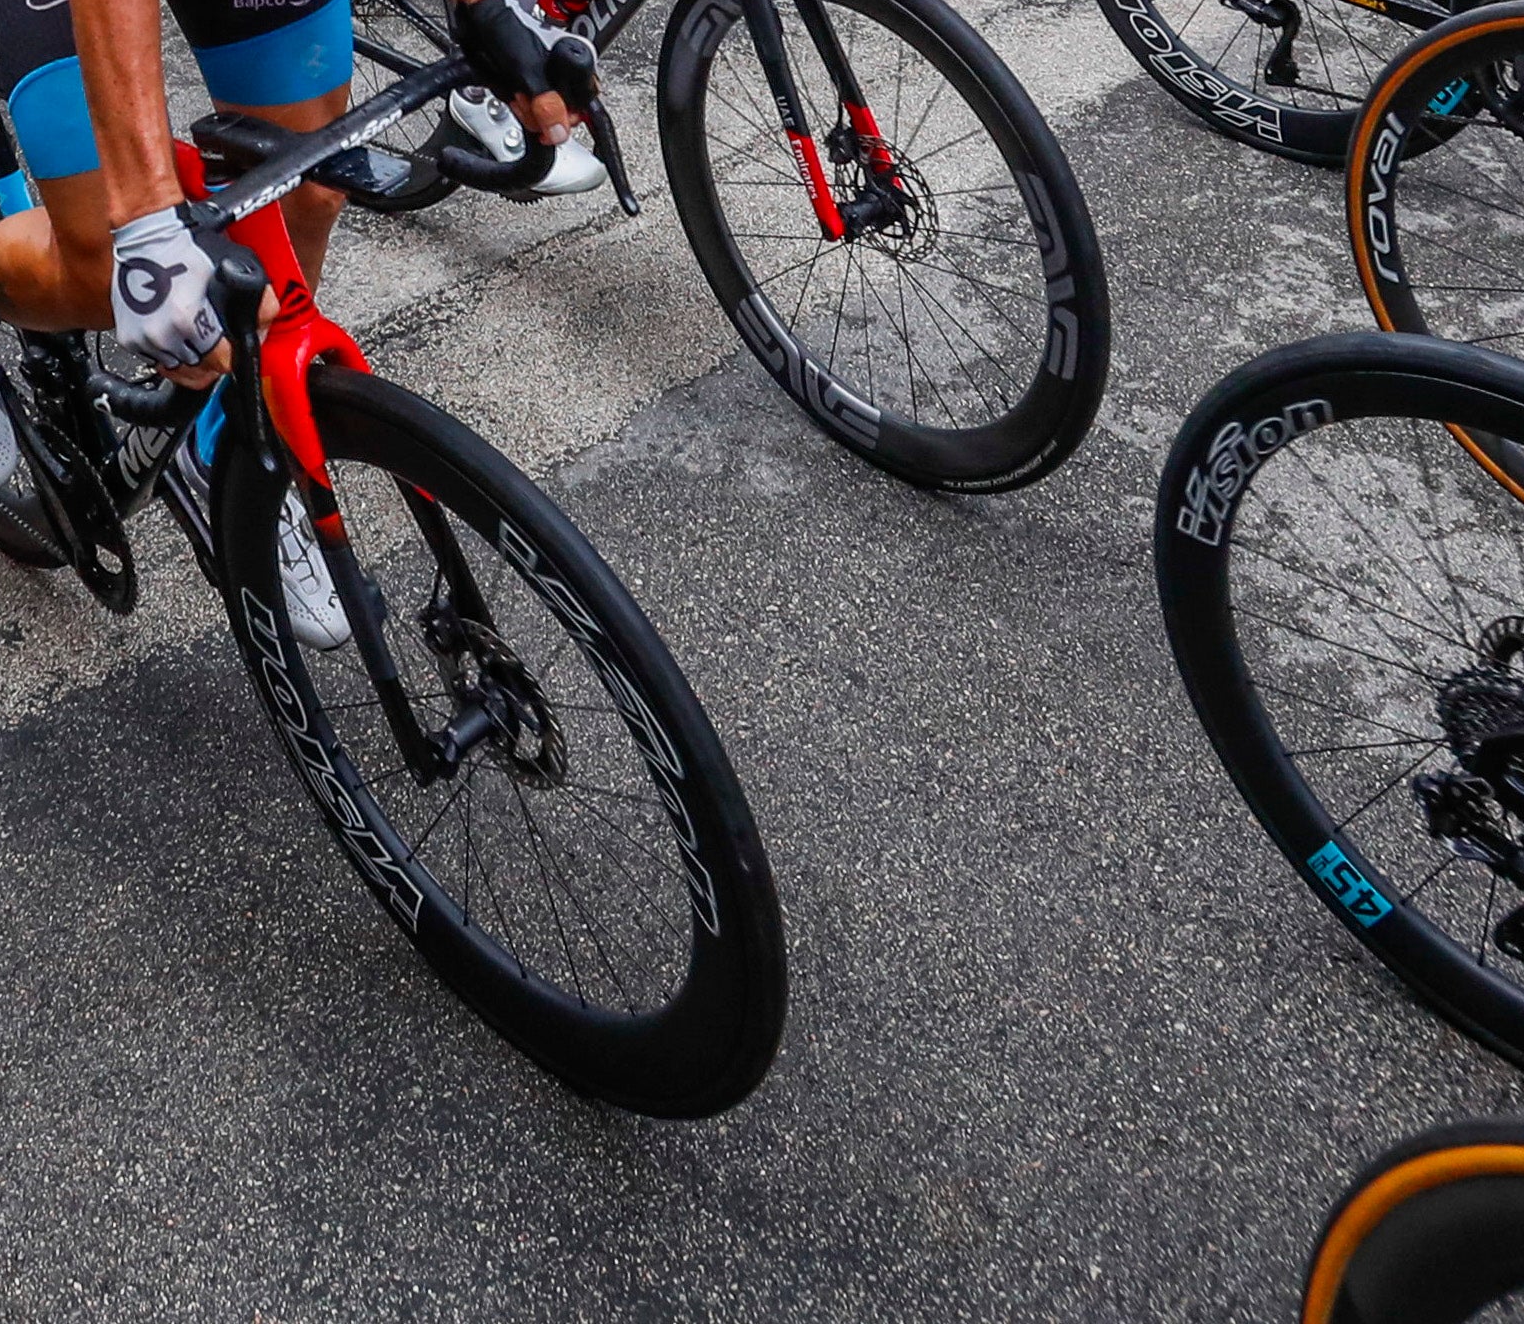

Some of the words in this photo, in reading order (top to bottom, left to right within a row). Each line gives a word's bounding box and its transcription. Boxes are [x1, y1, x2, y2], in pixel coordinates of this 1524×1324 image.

[775, 95, 796, 129] UAE
[788, 138, 820, 202] Emirates
[1368, 112, 1407, 284] roval
